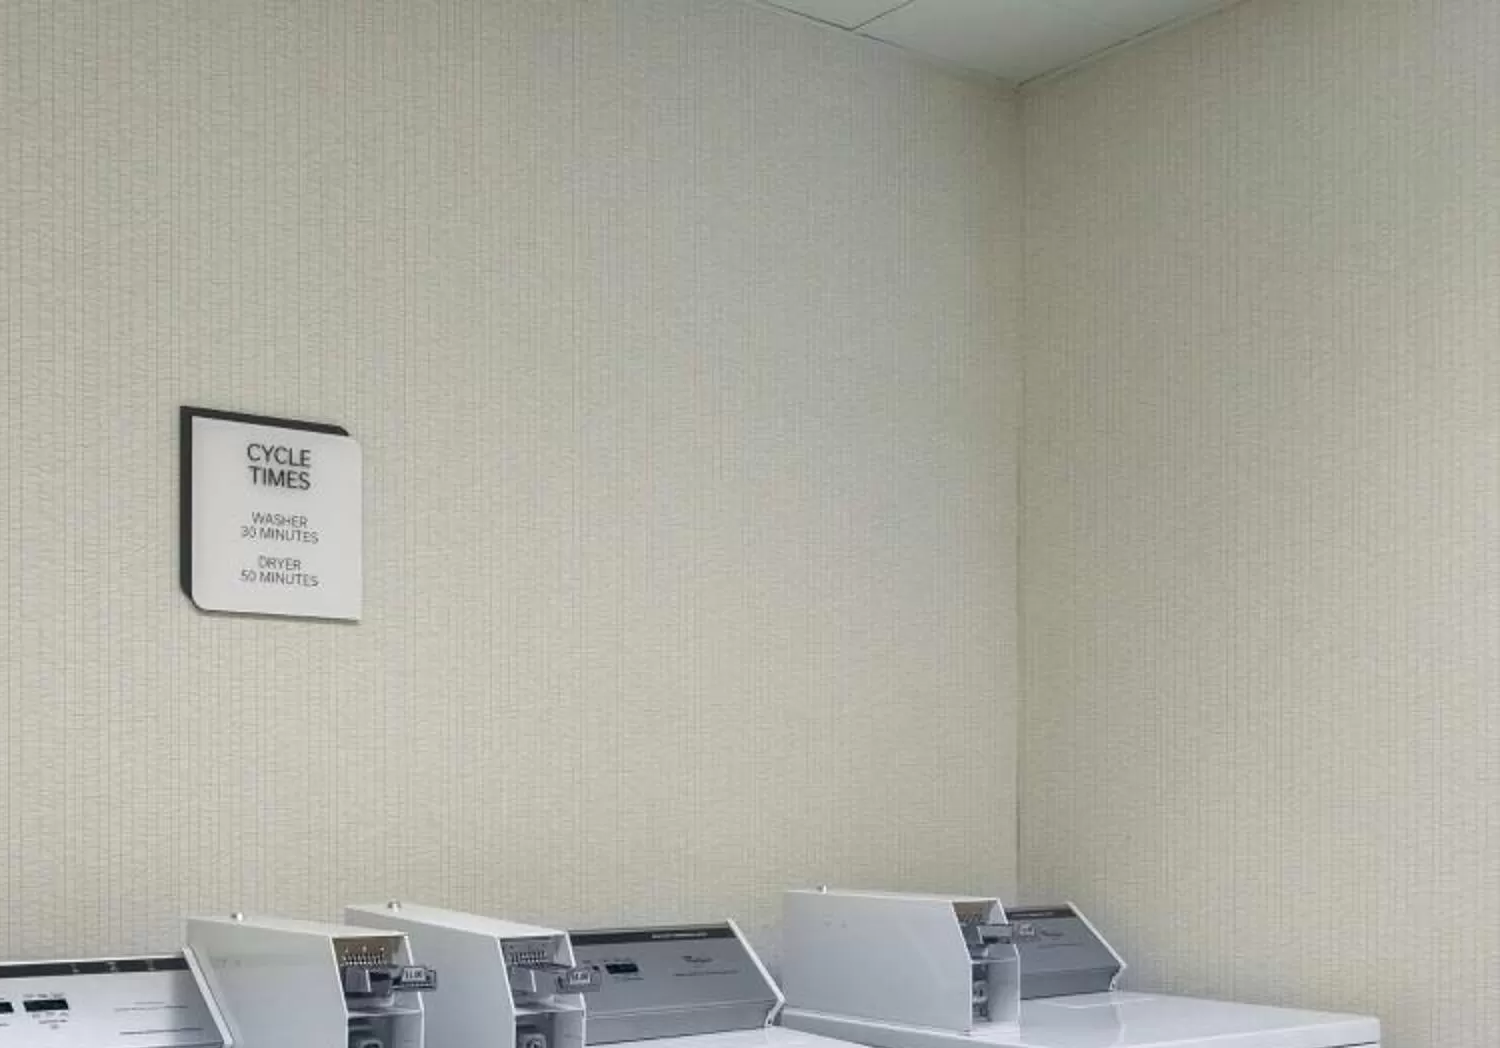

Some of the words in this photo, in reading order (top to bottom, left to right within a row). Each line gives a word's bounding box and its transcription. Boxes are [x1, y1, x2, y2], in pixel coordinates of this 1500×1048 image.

[247, 443, 311, 468] CYCLE
[247, 465, 311, 490] TIMES
[251, 511, 308, 529] WASHER
[240, 525, 257, 540] 30
[259, 527, 319, 544] MINUTES
[257, 555, 302, 571] DRYER
[240, 569, 257, 583] 50
[259, 571, 319, 587] MINUTES
